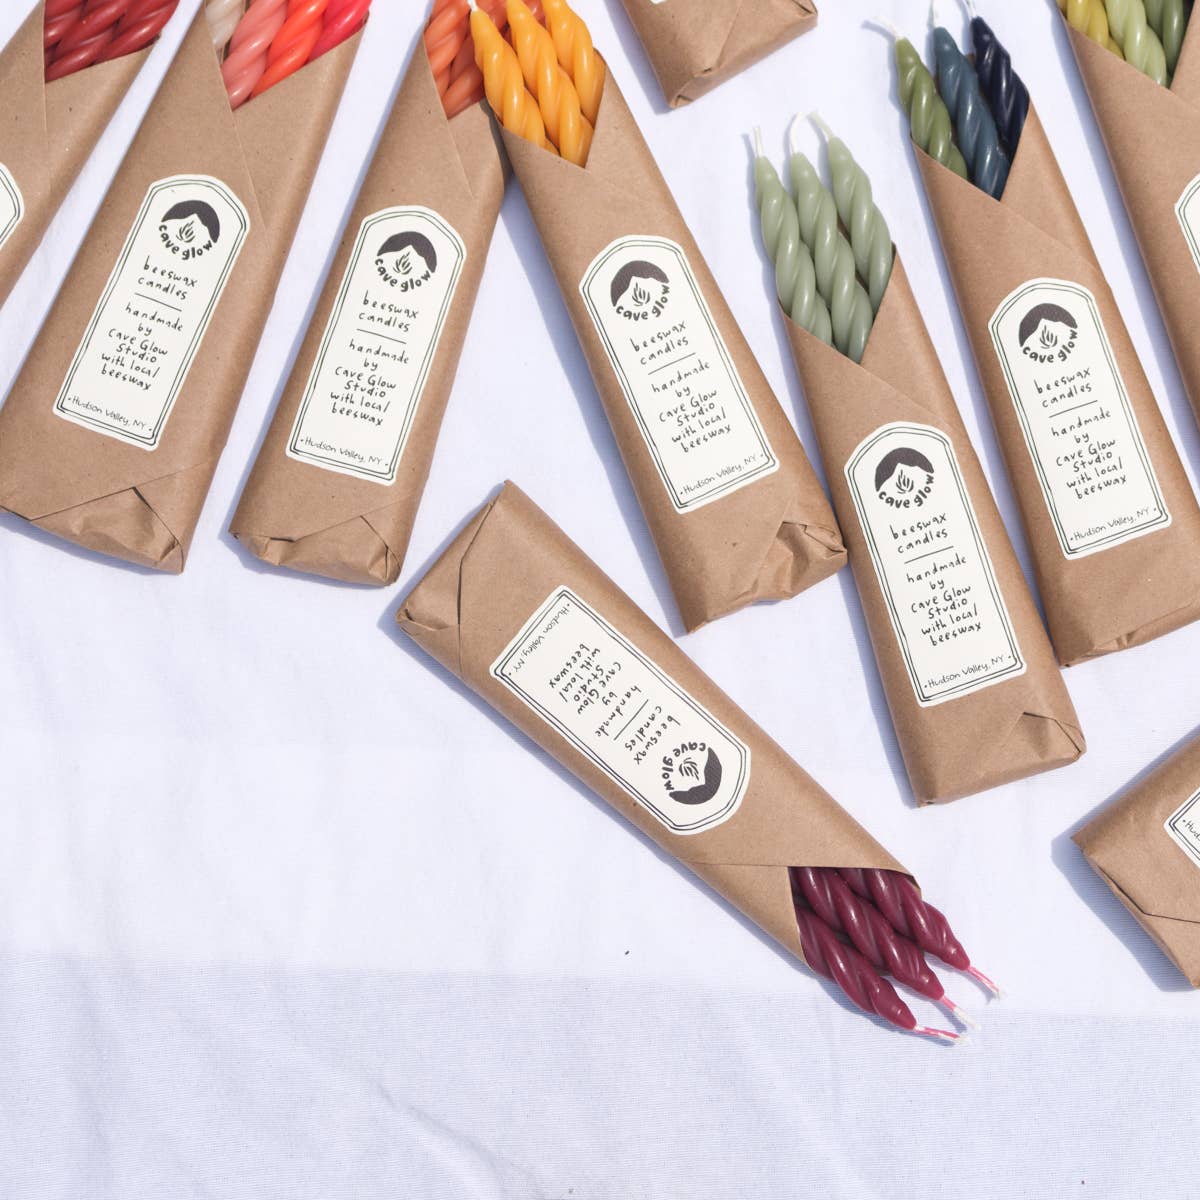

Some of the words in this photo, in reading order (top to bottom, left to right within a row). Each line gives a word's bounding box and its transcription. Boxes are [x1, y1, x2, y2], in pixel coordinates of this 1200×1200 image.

[158, 223, 180, 255] cave
[180, 239, 216, 261] glow
[142, 254, 198, 287] beeswax
[374, 257, 398, 288] cave
[400, 269, 434, 293] glow
[136, 276, 188, 301] candles
[615, 304, 649, 322] cave
[650, 281, 670, 318] glow
[124, 301, 183, 332] handmade
[362, 289, 419, 319] beeswax
[137, 322, 152, 337] by
[358, 312, 410, 333] candles
[139, 338, 168, 355] Glow
[629, 320, 686, 353] beeswax
[1021, 345, 1055, 364] cave
[1057, 326, 1078, 362] glow
[115, 342, 157, 364] Studio
[348, 338, 409, 364] handmade
[639, 335, 689, 366] candles
[100, 362, 152, 391] beeswax
[101, 352, 125, 368] with
[129, 358, 161, 379] local
[363, 358, 379, 372] by
[343, 379, 386, 398] Studio
[367, 373, 397, 389] Glow
[1033, 367, 1091, 395] beeswax
[329, 391, 355, 405] with
[359, 394, 391, 413] local
[1041, 382, 1092, 408] candles
[131, 418, 147, 430] NY
[331, 401, 384, 426] beeswax
[367, 455, 383, 465] NY
[877, 490, 911, 509] cave
[913, 471, 935, 507] glow
[889, 512, 947, 540] beeswax
[897, 528, 948, 554] candles
[905, 552, 966, 583] handmade
[928, 578, 945, 590] by
[942, 585, 971, 602] Glow
[920, 618, 947, 635] with
[948, 602, 978, 625] local
[927, 597, 968, 620] Studio
[928, 621, 981, 647] beeswax
[513, 657, 526, 673] NY
[548, 643, 591, 689] beeswax
[579, 647, 601, 671] with
[990, 654, 1004, 666] NY
[558, 672, 584, 703] local
[573, 664, 604, 702] Studio
[576, 687, 600, 715] Glow
[594, 684, 642, 737] handmade
[601, 690, 617, 706] by
[624, 705, 663, 752] candles
[633, 714, 681, 765] beeswax
[672, 740, 707, 758] cave
[661, 755, 675, 795] glow
